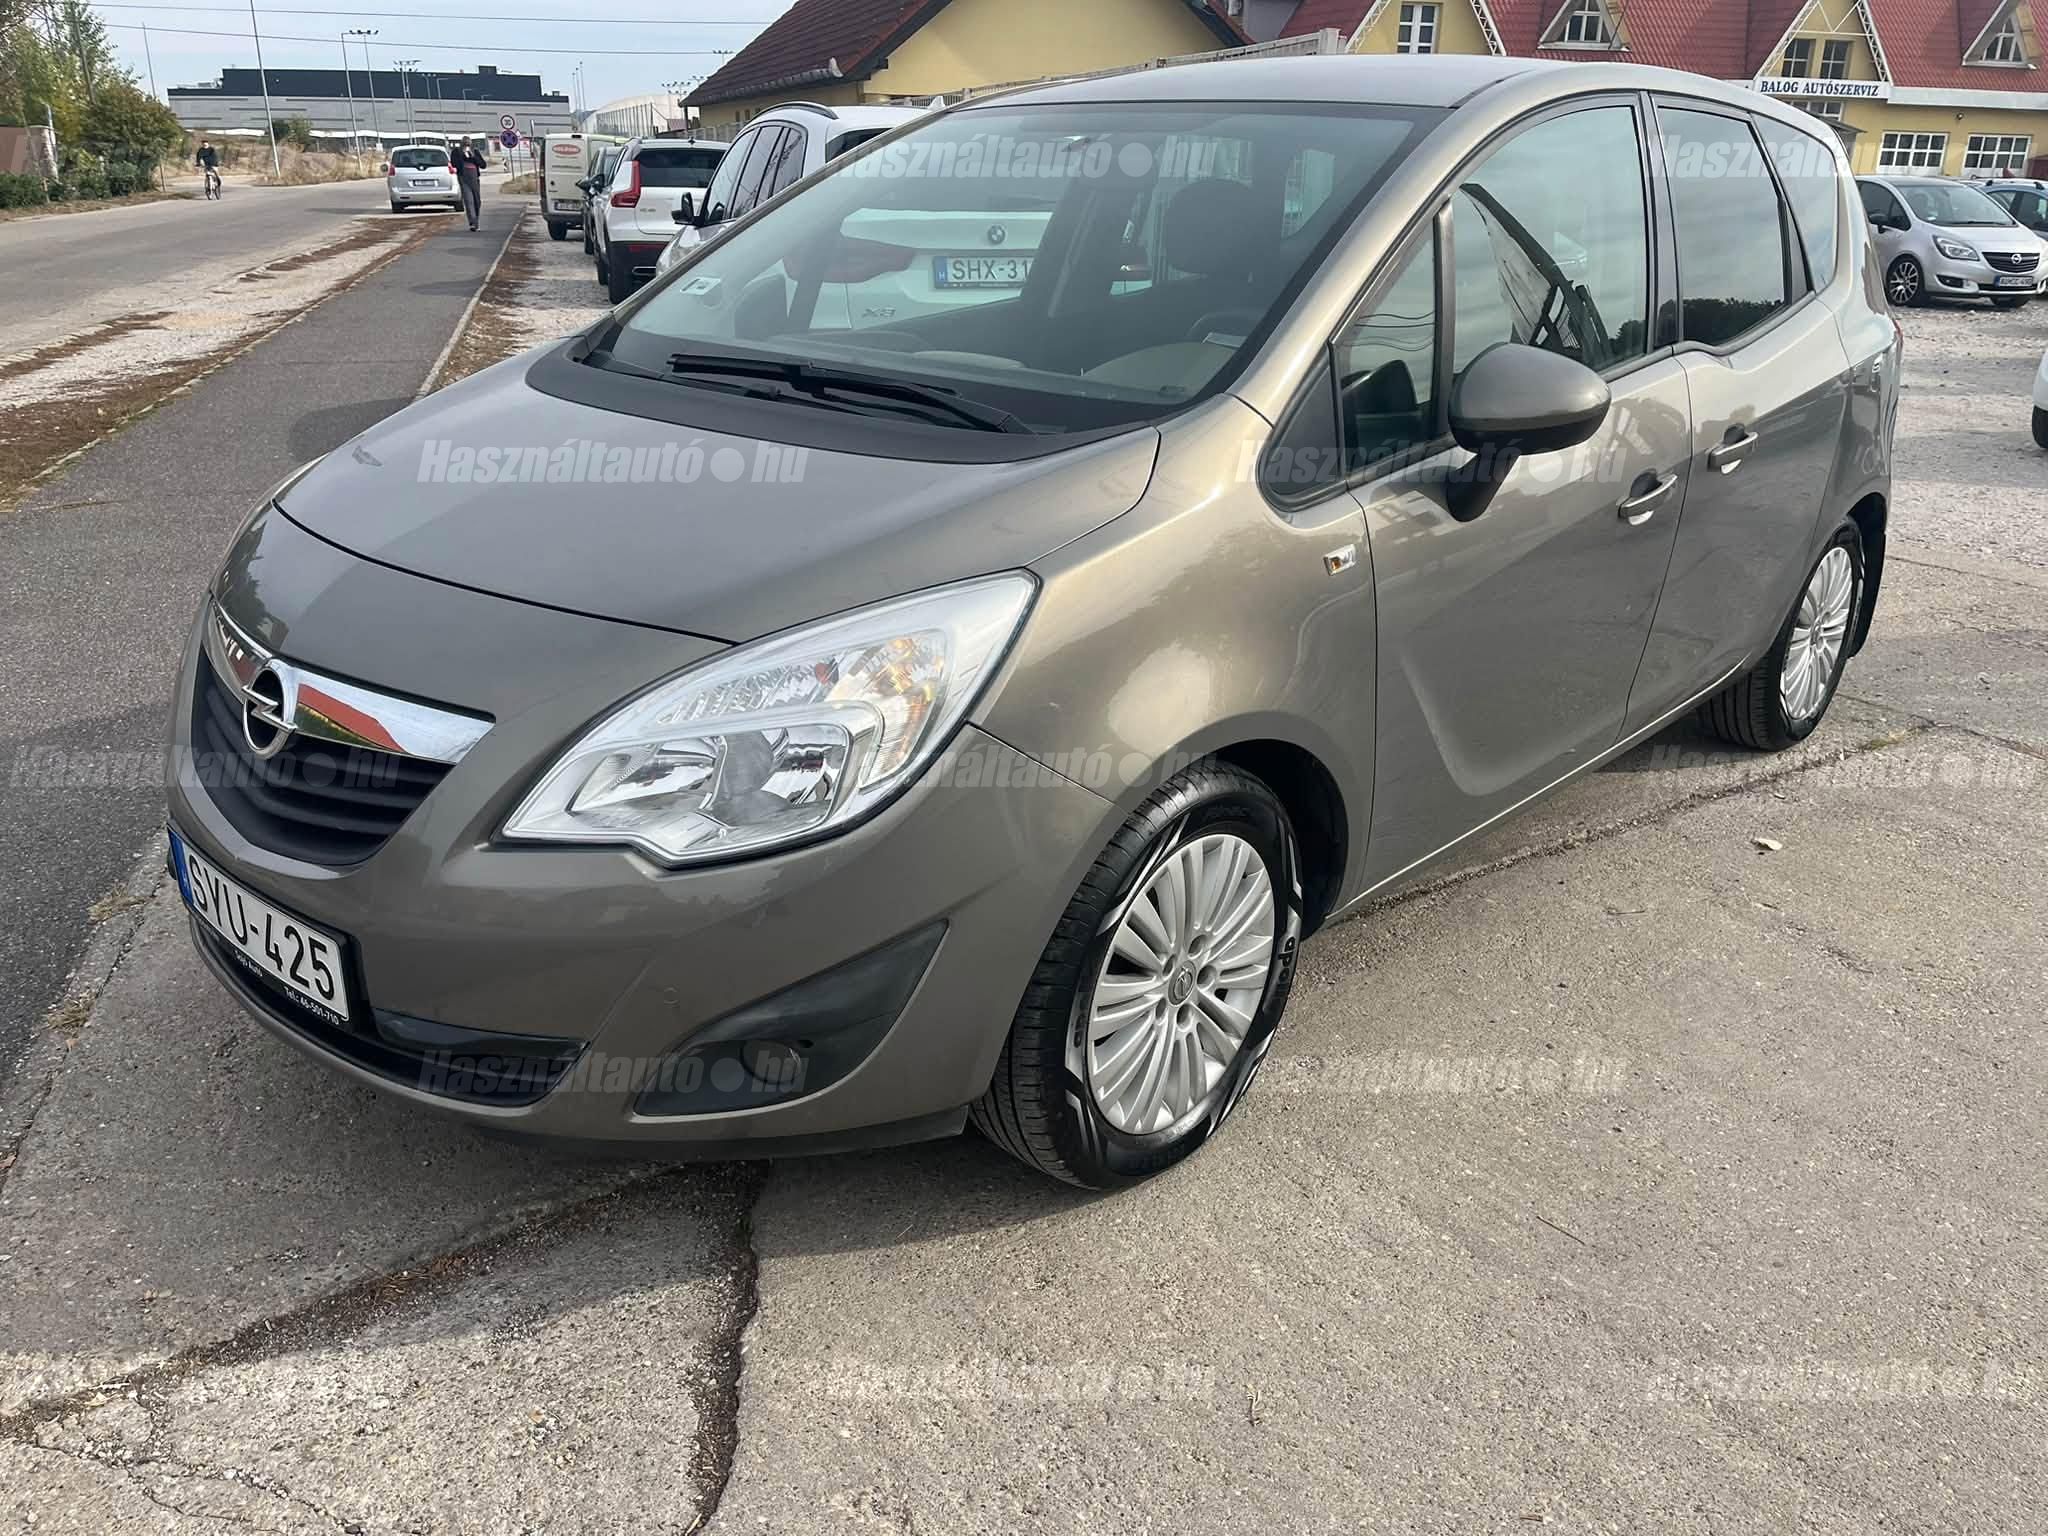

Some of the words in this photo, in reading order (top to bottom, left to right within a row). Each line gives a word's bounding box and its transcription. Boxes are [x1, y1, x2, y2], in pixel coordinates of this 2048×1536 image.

[1760, 80, 1799, 93] BALOG
[1802, 81, 1880, 97] AUTÓSZERVIZ
[189, 854, 335, 1001] SYU-425
